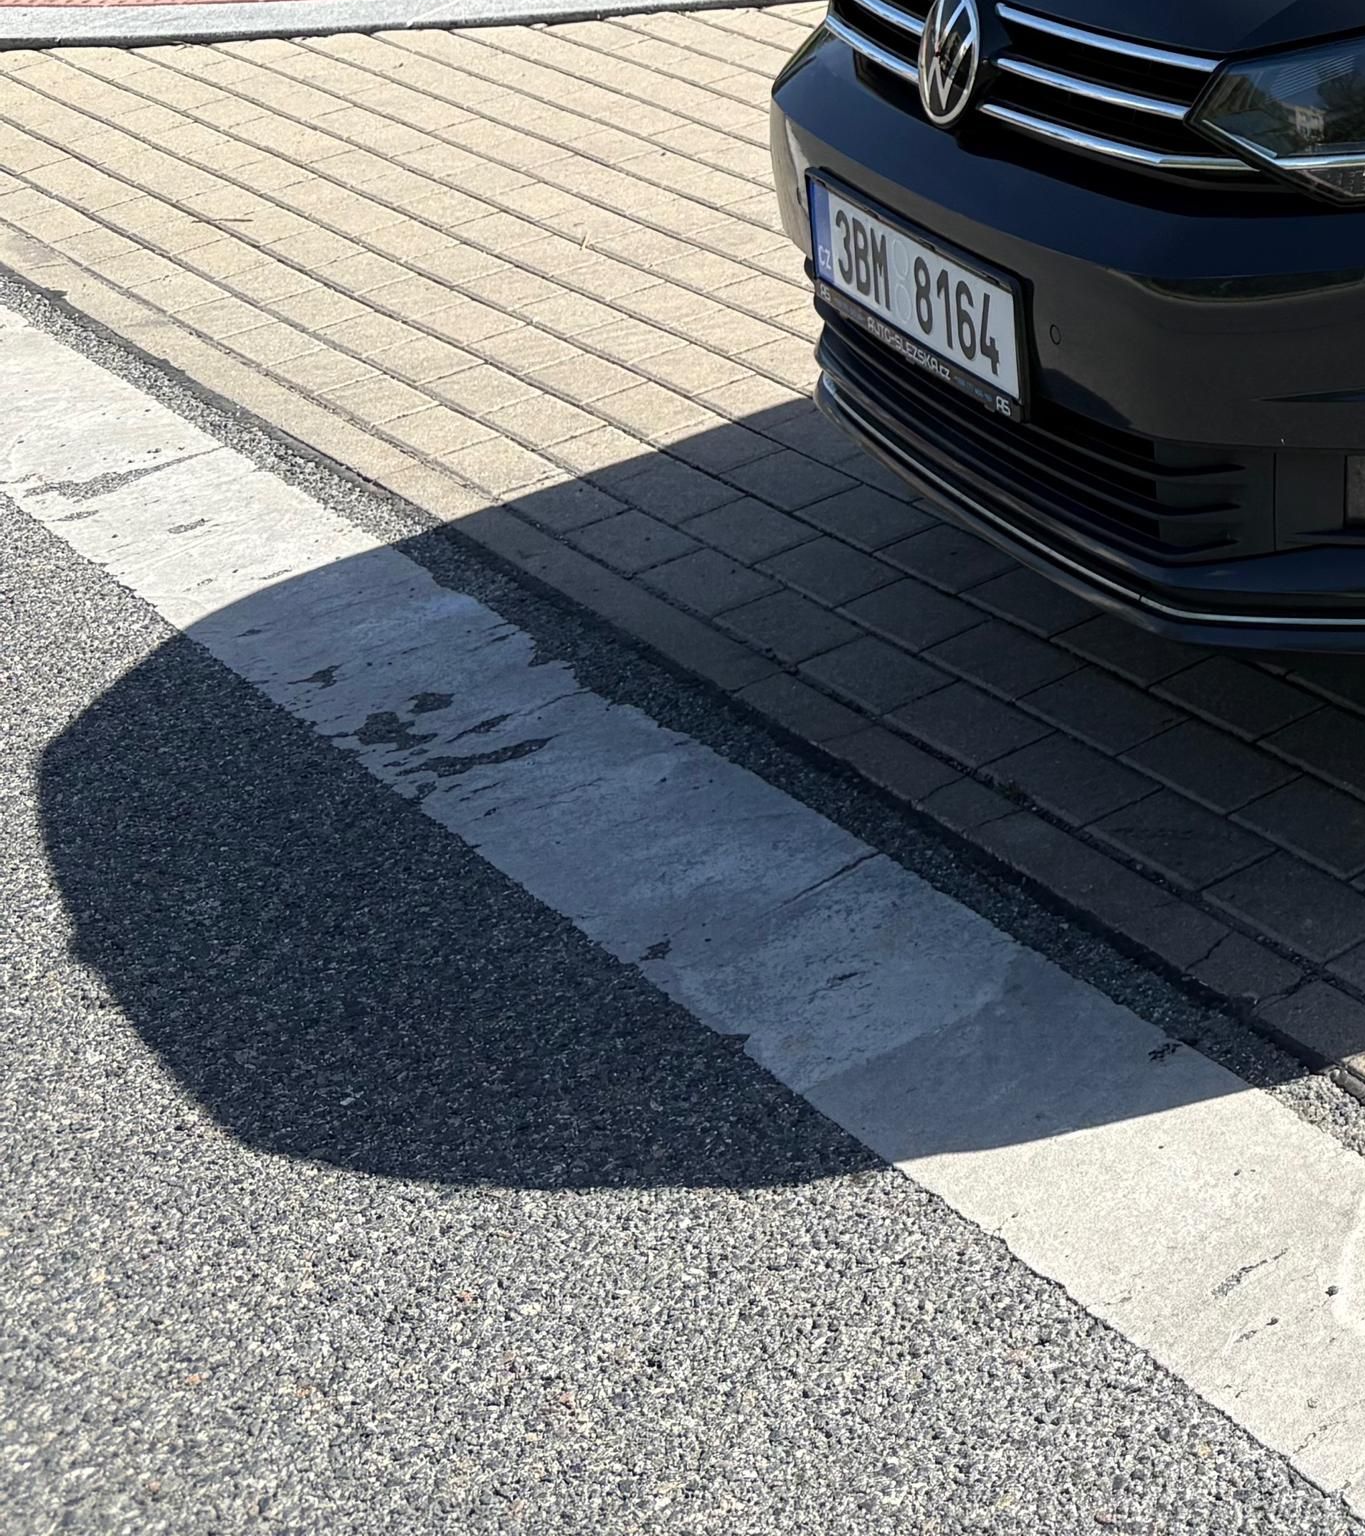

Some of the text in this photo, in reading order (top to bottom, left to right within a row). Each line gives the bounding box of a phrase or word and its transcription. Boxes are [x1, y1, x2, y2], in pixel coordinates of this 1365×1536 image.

[818, 245, 832, 271] CZ
[835, 210, 1000, 376] 3BM 8164
